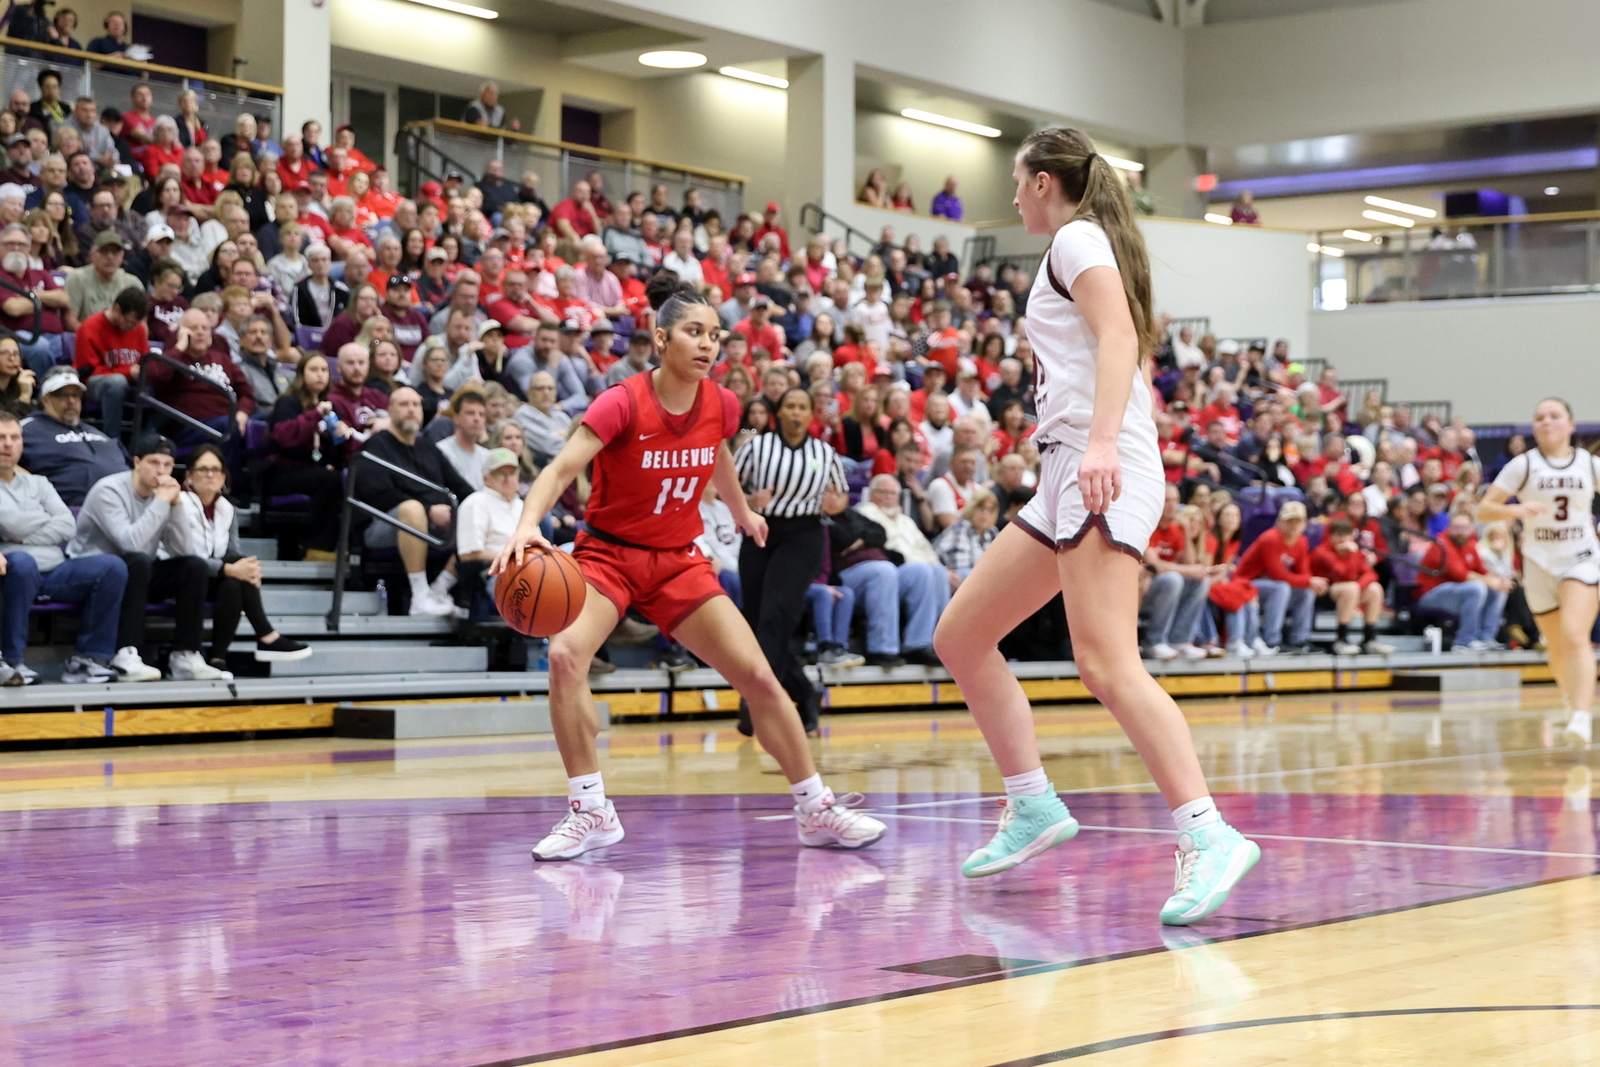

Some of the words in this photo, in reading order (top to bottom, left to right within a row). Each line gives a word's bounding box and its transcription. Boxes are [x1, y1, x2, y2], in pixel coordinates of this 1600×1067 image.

[641, 446, 715, 469] BELLEVUE
[653, 476, 699, 515] 14
[1553, 494, 1570, 521] 3
